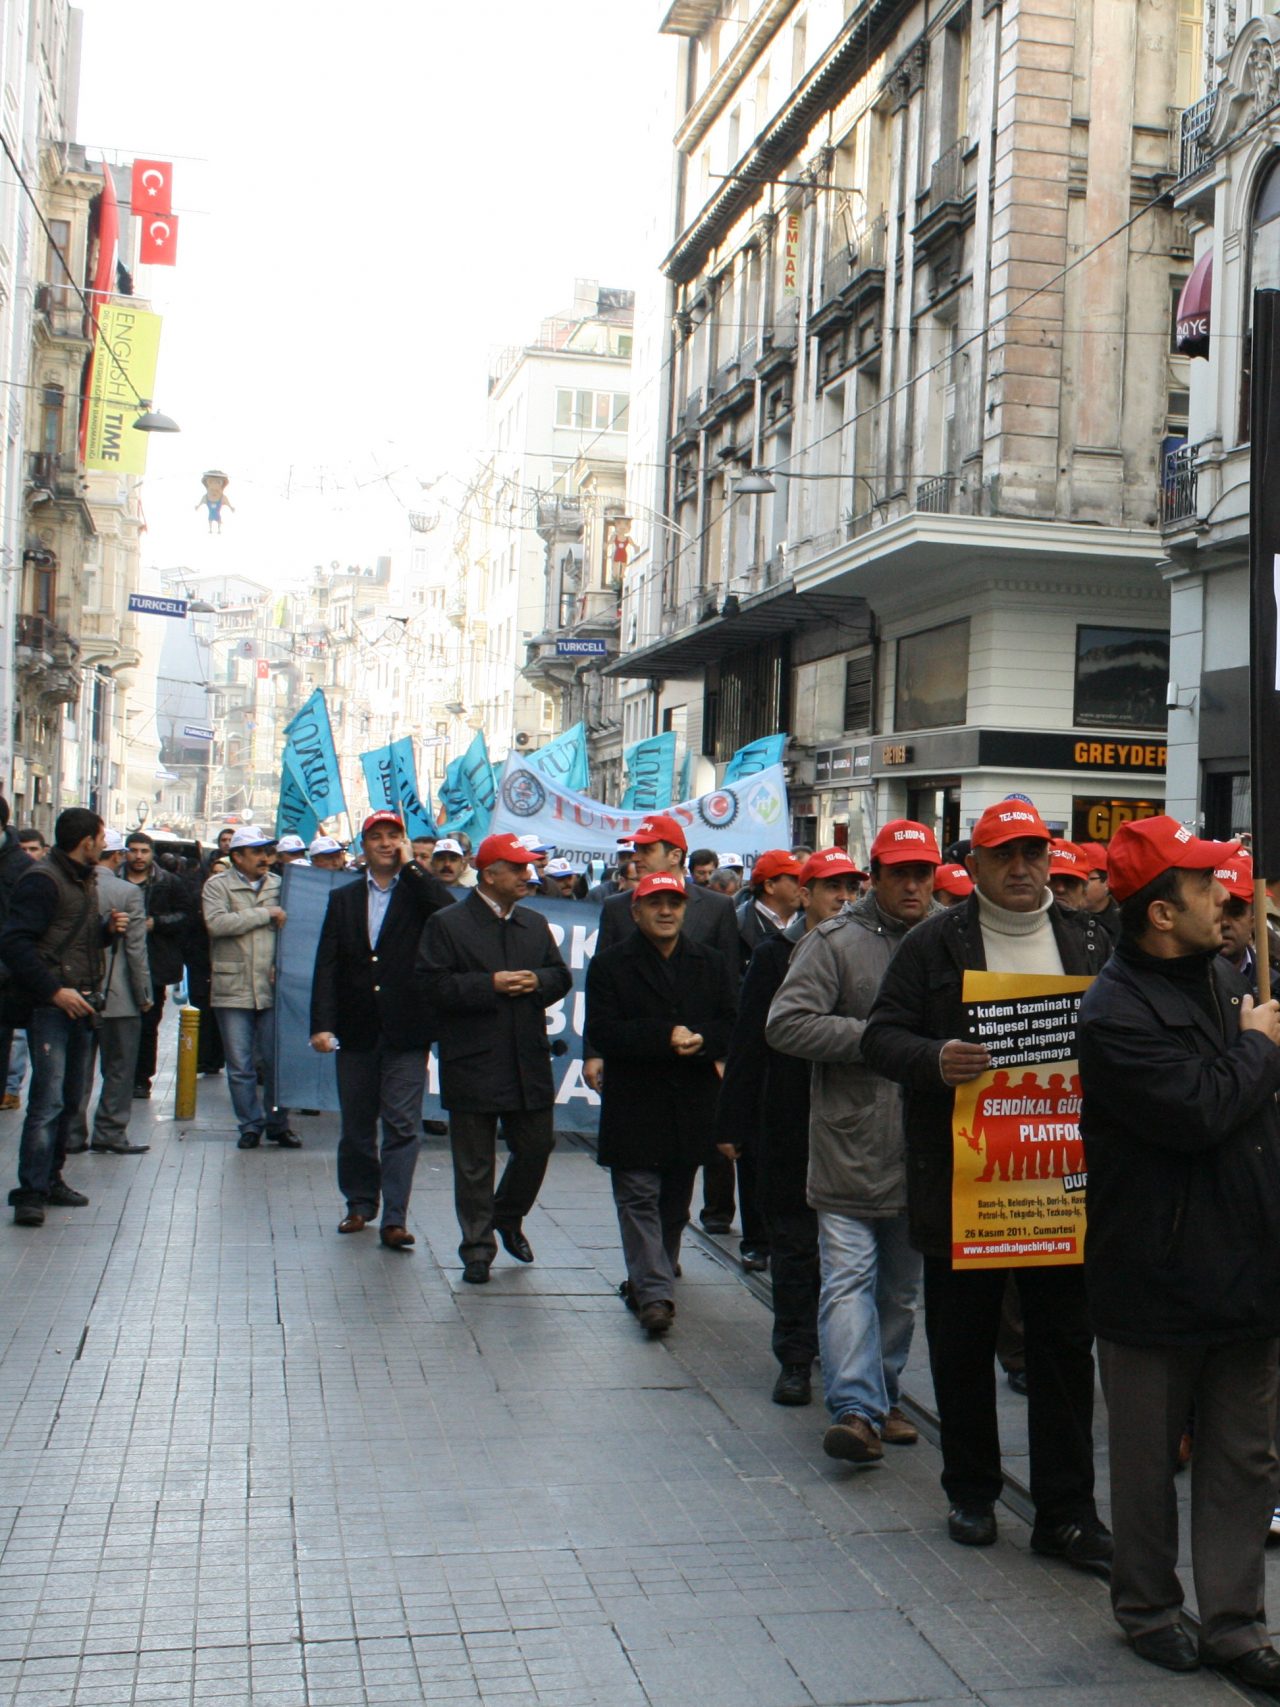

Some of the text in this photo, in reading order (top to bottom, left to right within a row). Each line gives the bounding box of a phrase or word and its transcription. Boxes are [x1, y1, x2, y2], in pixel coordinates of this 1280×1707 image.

[784, 216, 798, 288] EMLAK
[101, 312, 135, 461] ENGLISH TIME
[131, 597, 185, 614] TURKCELL
[557, 642, 604, 653] TURKCELL
[1074, 741, 1168, 768] GREYDER
[977, 1002, 1014, 1019] kıdem
[1016, 997, 1071, 1016] tazminatı
[978, 1018, 1029, 1036] bölgesel
[1031, 1013, 1068, 1029] asgari
[1017, 1030, 1076, 1050] çalışmaya
[983, 1096, 1052, 1117] SENDİKAL
[1033, 1224, 1076, 1236] Cumartesi
